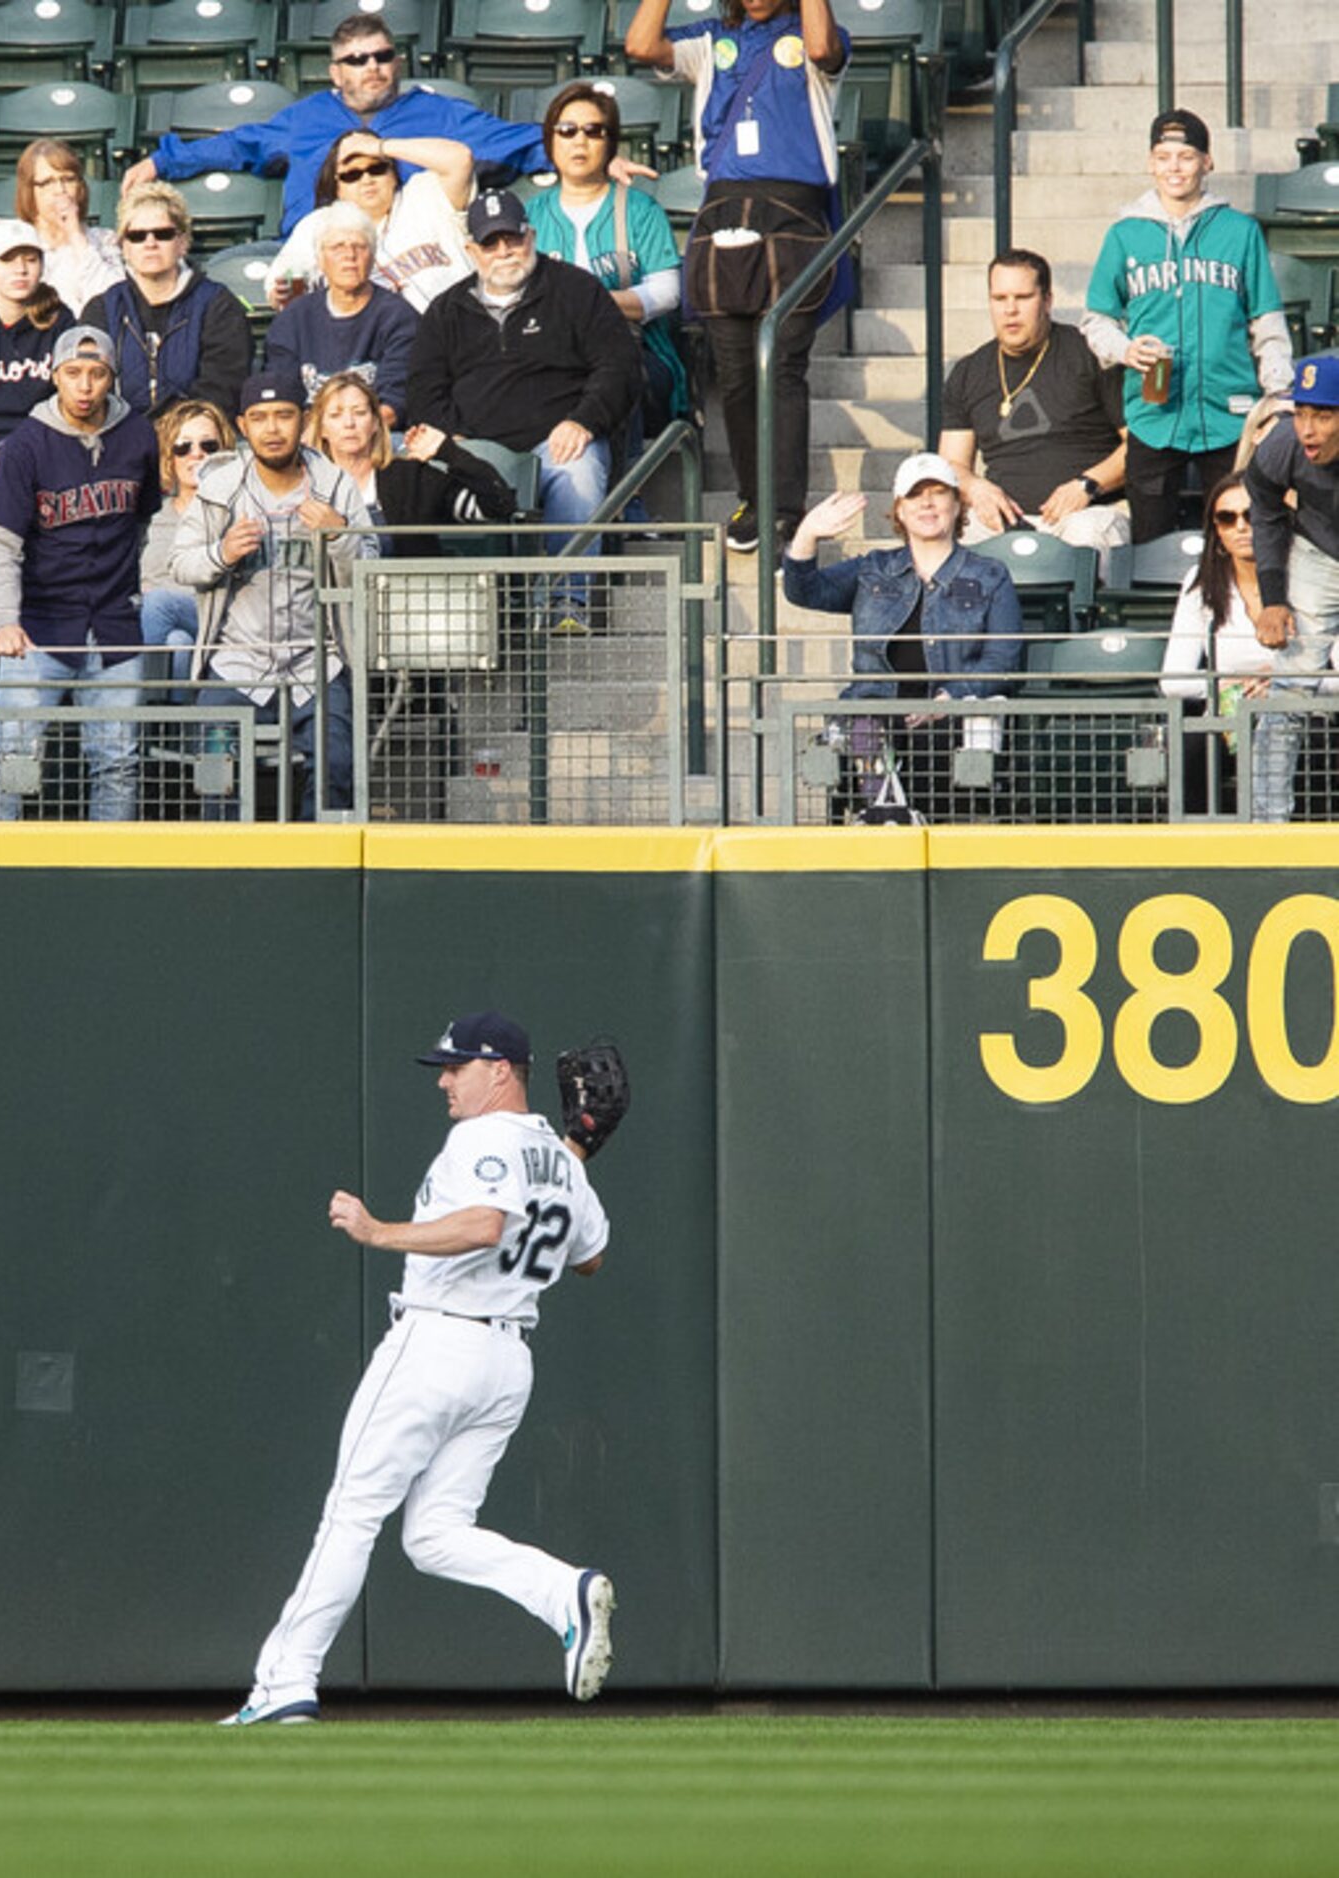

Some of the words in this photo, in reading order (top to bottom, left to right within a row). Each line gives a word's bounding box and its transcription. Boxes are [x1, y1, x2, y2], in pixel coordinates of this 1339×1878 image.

[1301, 364, 1318, 390] S
[980, 893, 1339, 1104] 380
[498, 1200, 571, 1283] 32
